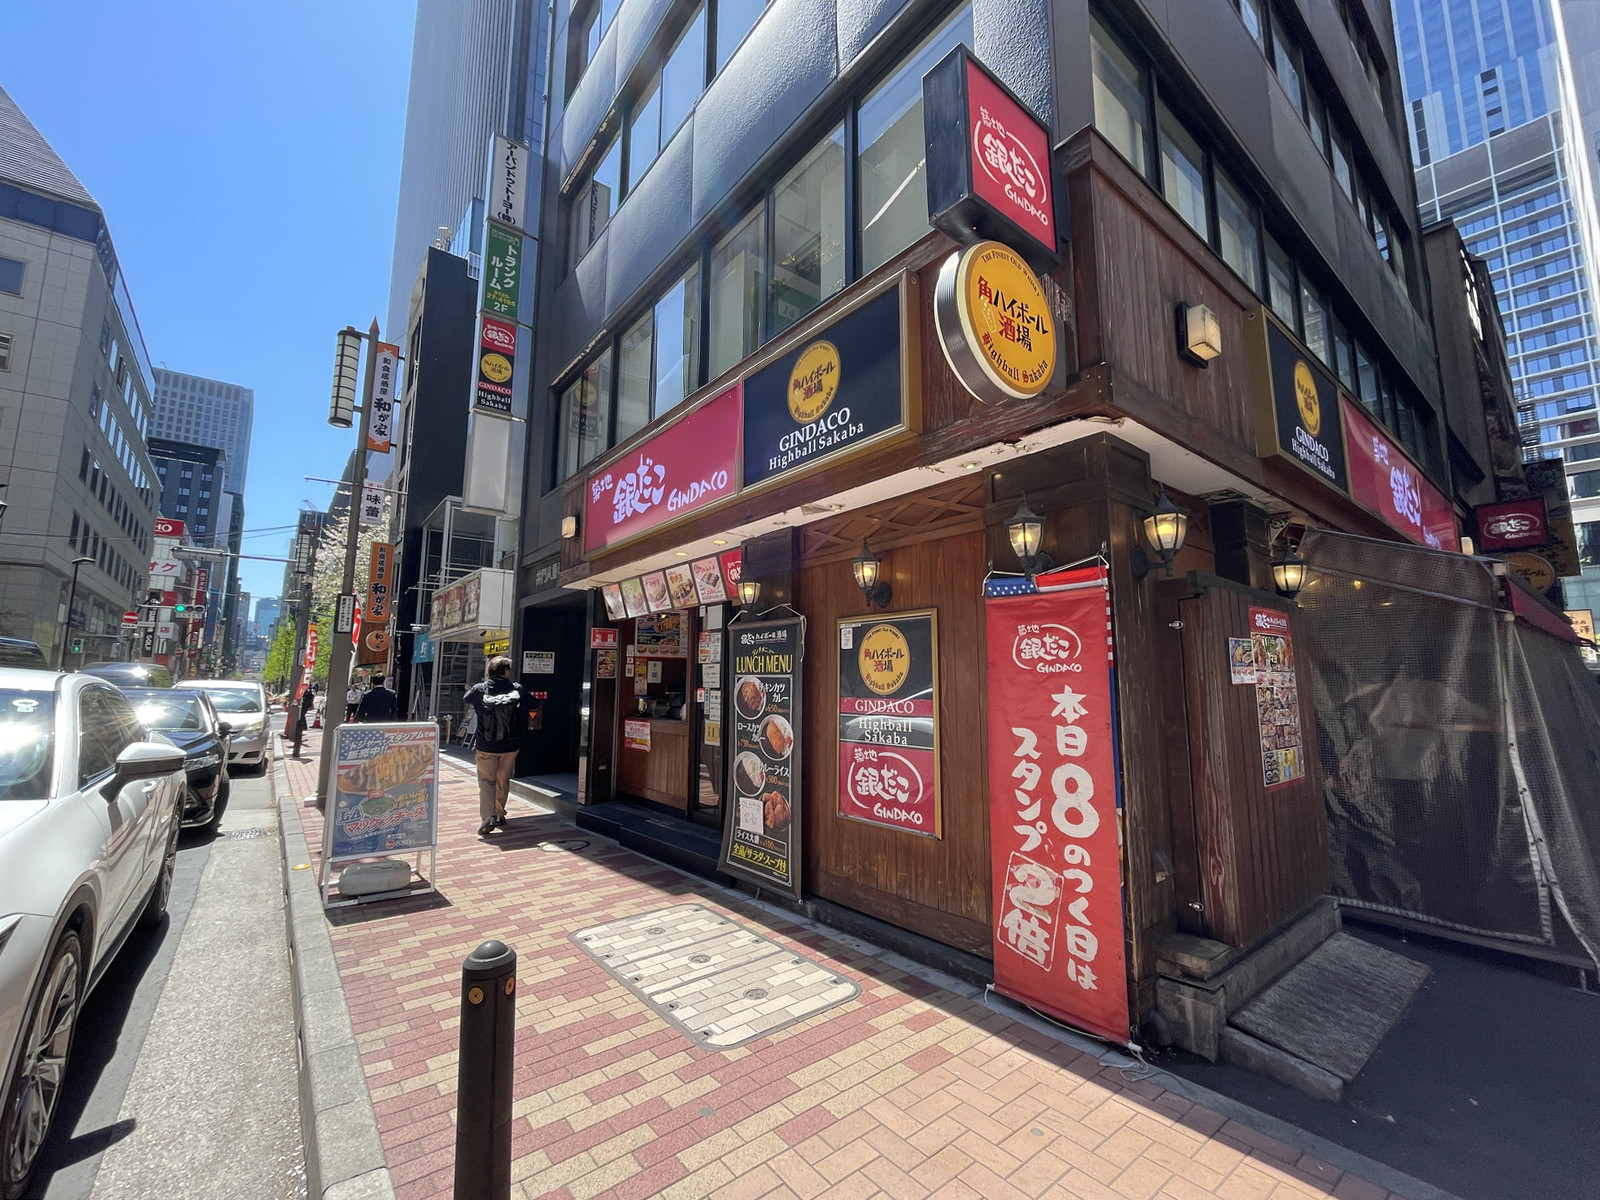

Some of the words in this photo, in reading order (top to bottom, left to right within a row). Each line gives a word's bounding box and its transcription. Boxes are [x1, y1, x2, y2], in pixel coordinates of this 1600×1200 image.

[982, 132, 1037, 198] 銀だこ
[1004, 183, 1048, 226] GINDACO
[489, 256, 503, 290] ルーム
[503, 245, 518, 288] トランク
[493, 302, 508, 312] 2F
[977, 275, 1049, 335] 角ハイボール
[998, 311, 1032, 352] 酒場
[1022, 359, 1049, 383] Sakaba
[478, 382, 512, 395] GINDACO
[478, 391, 511, 404] Highball
[803, 379, 824, 401] 酒場
[480, 399, 507, 410] Sakaba
[779, 407, 851, 453] GINDACO
[769, 442, 818, 471] Highball
[818, 422, 865, 451] Sakaba
[1291, 438, 1318, 467] Highball
[1295, 426, 1329, 462] GINDACO
[612, 453, 666, 524] 銀だこ
[667, 470, 728, 512] GINDACO
[1017, 624, 1040, 636] 築地
[864, 647, 905, 660] 角ハイボール
[1020, 632, 1070, 661] 銀だこ
[736, 655, 764, 673] LUNCH
[766, 654, 793, 673] MENU
[874, 660, 894, 672] 酒場
[1036, 662, 1082, 673] GINDACO
[760, 682, 786, 693] チキンカツ
[772, 692, 789, 703] カレー
[855, 699, 914, 714] GINDACO
[738, 722, 761, 733] ロースカツ
[859, 718, 912, 733] Highball
[864, 729, 907, 745] Sakaba
[854, 747, 878, 763] 築地
[760, 762, 790, 777] カレーライス
[855, 764, 909, 803] 銀だこ
[874, 803, 923, 825] GINDACO
[1050, 684, 1100, 990] 本日8のつく日は
